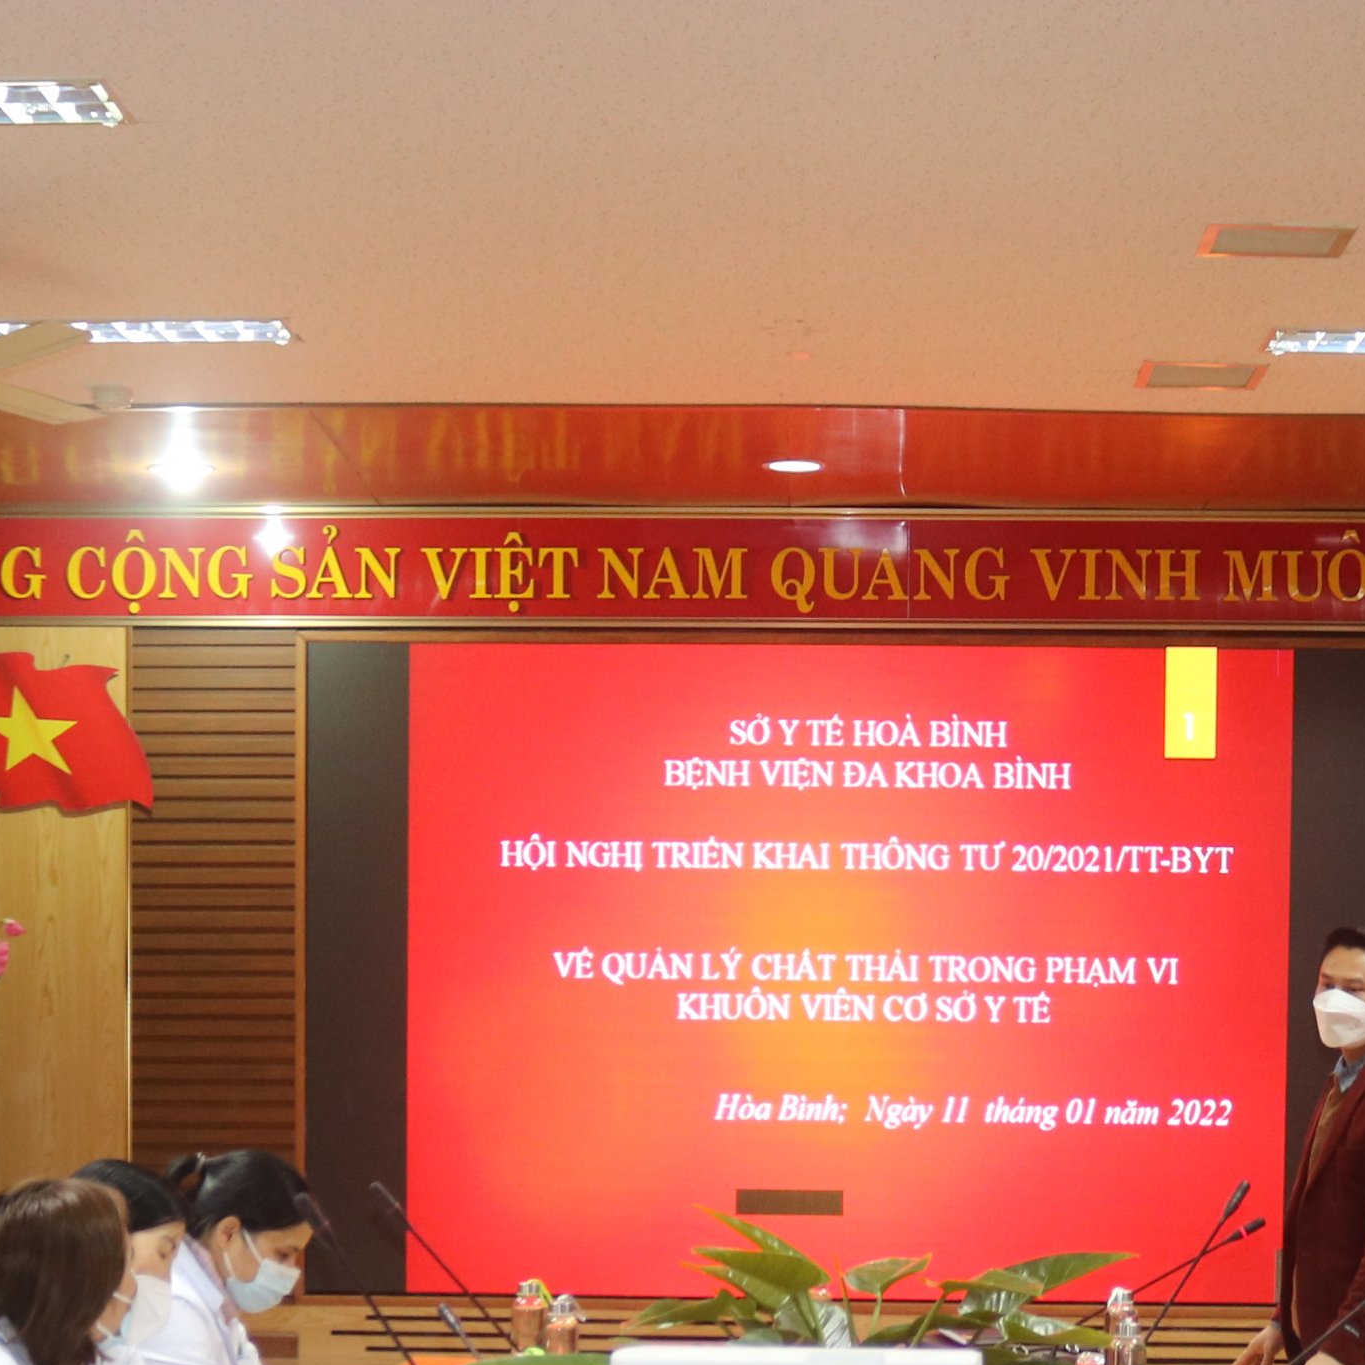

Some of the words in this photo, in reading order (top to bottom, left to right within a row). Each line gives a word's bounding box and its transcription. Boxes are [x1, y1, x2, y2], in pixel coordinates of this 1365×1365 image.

[67, 529, 253, 614] CỘNG
[270, 525, 401, 600] SẢN
[420, 532, 578, 612] VIỆT
[597, 547, 748, 600] NAM
[770, 547, 1011, 614] QUANG
[1030, 548, 1201, 601] VINH
[728, 712, 773, 746] SỞ
[777, 718, 801, 747] Y
[928, 713, 1008, 748] BÌNH
[1182, 711, 1196, 742] 1
[663, 756, 752, 791] BỆNH
[758, 756, 836, 791] VIỆN
[842, 760, 890, 789] ĐA
[893, 760, 986, 790] KHOA
[992, 755, 1072, 790] BÌNH
[500, 832, 557, 871] HỘI
[751, 840, 831, 871] KHAI
[839, 835, 952, 871] THÔNG
[958, 840, 1007, 872] TƯ
[1010, 843, 1234, 874] 20/2021/TT-BYT
[600, 946, 695, 986] QUẢN
[699, 946, 744, 981] LÝ
[844, 948, 920, 983] THẢI
[927, 953, 1038, 984] TRONG
[1045, 955, 1137, 988] PHẠM
[1146, 956, 1179, 985] VI
[676, 984, 792, 1021] KHUÔN
[799, 986, 876, 1022] VIÊN
[881, 991, 931, 1023] CƠ
[934, 989, 979, 1023] SỞ
[982, 994, 1007, 1024] Y
[713, 1091, 774, 1121] Hòa
[864, 1094, 935, 1130] Ngày
[941, 1095, 971, 1124] 11
[983, 1095, 1060, 1132] tháng
[1064, 1097, 1097, 1125] 01
[1103, 1099, 1160, 1126] năm
[1166, 1097, 1233, 1127] 2022
